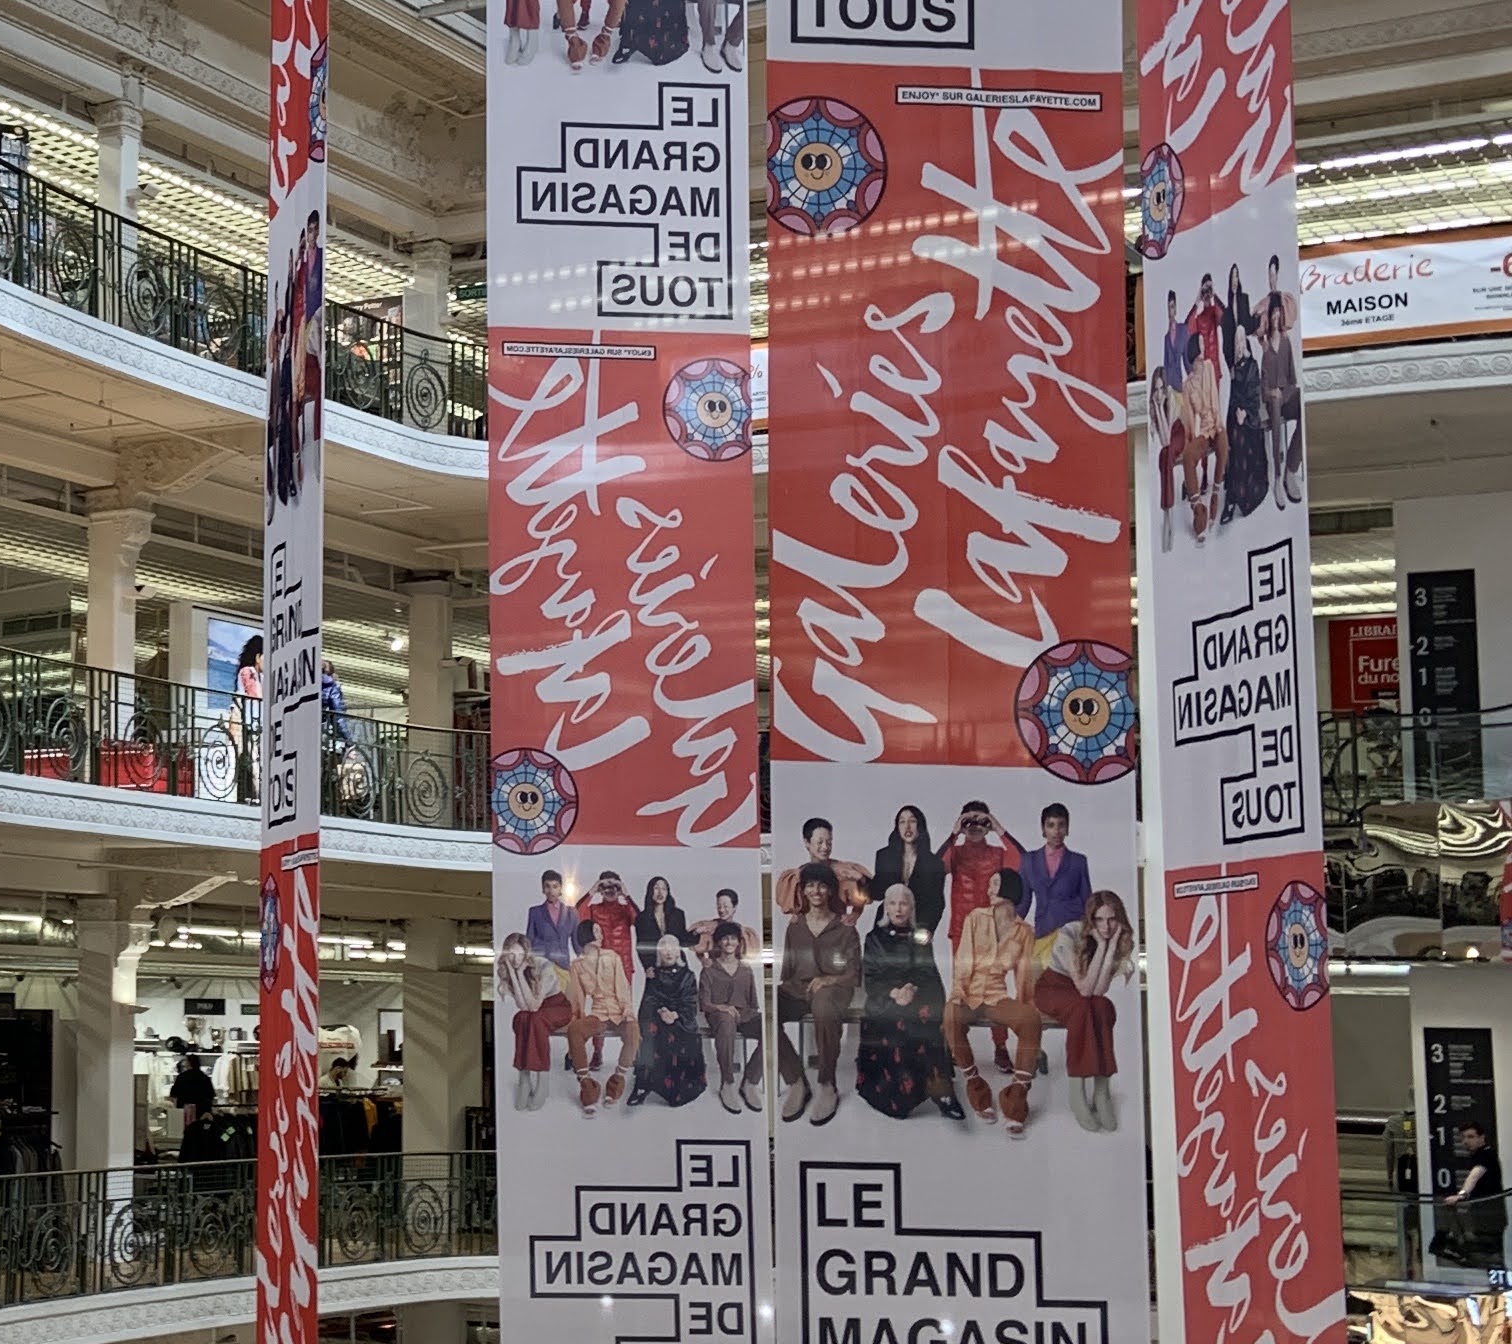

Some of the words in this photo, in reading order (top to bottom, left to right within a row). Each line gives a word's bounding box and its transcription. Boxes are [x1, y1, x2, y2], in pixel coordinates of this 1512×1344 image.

[942, 92, 963, 101] SUR
[966, 94, 1097, 106] GALERIESLAFAYETTE.COM
[1300, 255, 1433, 294] Braderie
[1326, 292, 1408, 316] MAISON
[1414, 587, 1428, 607] 3
[1350, 624, 1396, 637] LIBRAI
[1416, 636, 1429, 656] 2
[1358, 656, 1400, 673] Fure
[1358, 672, 1378, 684] du
[1381, 672, 1400, 684] no
[1419, 667, 1428, 686] 1
[1430, 1043, 1444, 1063] 3
[1433, 1094, 1447, 1114] 2
[1437, 1127, 1445, 1146] 1
[1437, 1168, 1451, 1188] 0
[816, 1182, 885, 1228] LE
[816, 1248, 1025, 1298] GRAND
